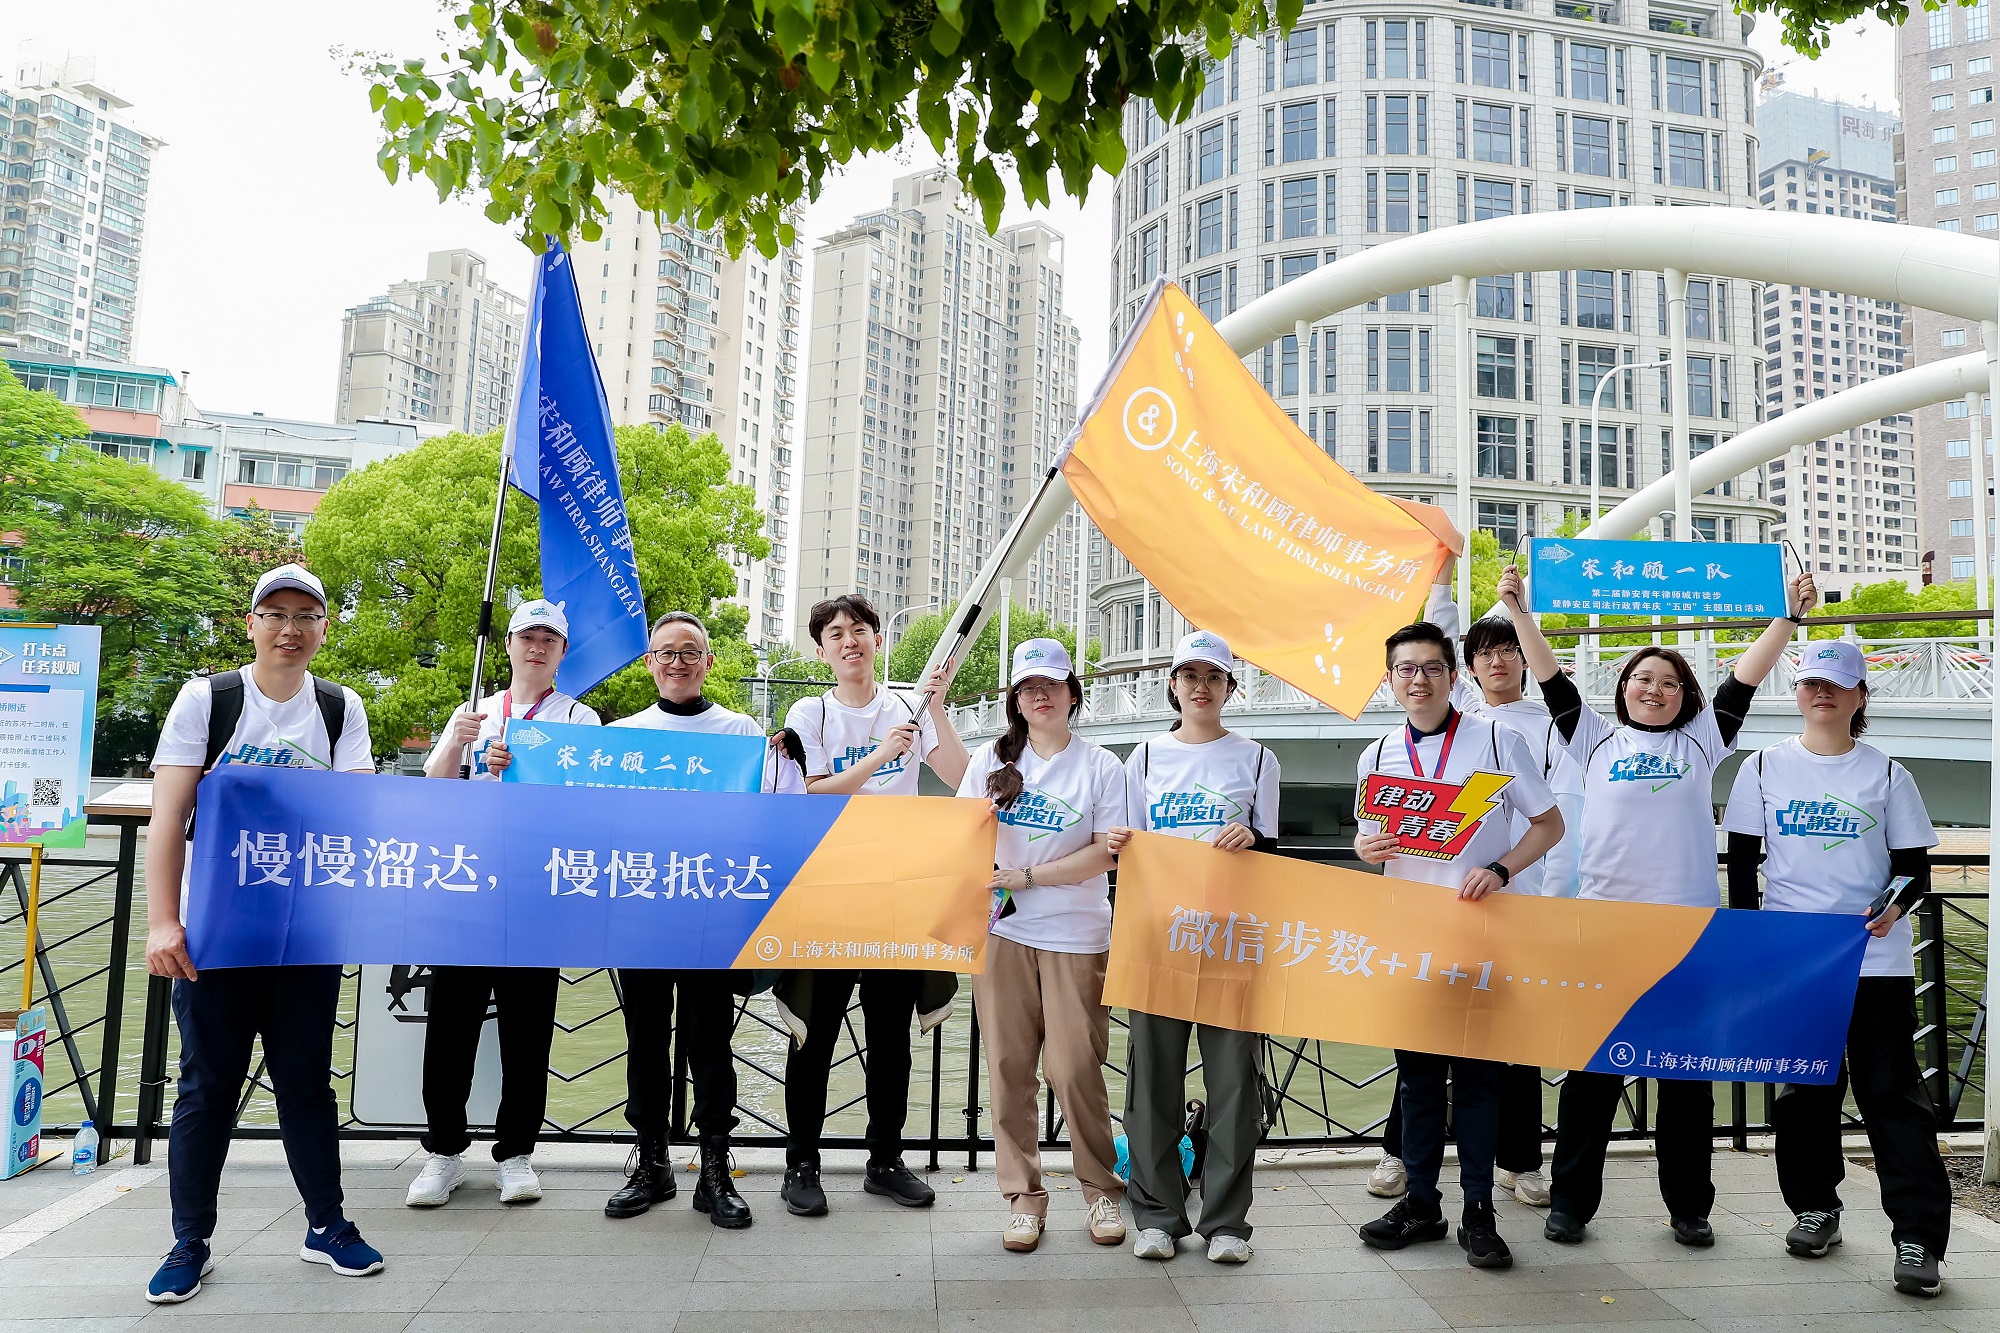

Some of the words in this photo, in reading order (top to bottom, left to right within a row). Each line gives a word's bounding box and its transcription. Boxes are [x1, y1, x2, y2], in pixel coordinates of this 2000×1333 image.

[1174, 429, 1423, 584] 上海宋和顾律师事务所
[1162, 454, 1203, 491] SONG
[1202, 487, 1216, 502] &
[1217, 499, 1240, 520] GU
[1239, 514, 1277, 542] LAW
[1276, 537, 1405, 603] FIRM,SHANGHAI
[558, 491, 643, 619] FIRM,SHANGHAI
[1581, 558, 1733, 581] 宋和顾一队
[1591, 588, 1722, 600] 第二届静安青年律师城市徒步
[22, 642, 67, 657] 打卡点
[21, 659, 81, 675] 任务规则
[0, 748, 67, 756] 成功的画面给工作人
[556, 744, 713, 775] 宋和顾二队
[1373, 785, 1436, 812] 律动
[1015, 805, 1067, 826] 静安行
[1177, 804, 1227, 821] 静安行
[1806, 815, 1861, 833] 静安行
[1396, 815, 1461, 842] 青春
[231, 829, 498, 892] 慢慢溜达，
[543, 847, 772, 900] 慢慢抵达
[786, 940, 975, 963] 上海宋和顾律师事务所
[1639, 1050, 1829, 1076] 上海宋和顾律师事务所
